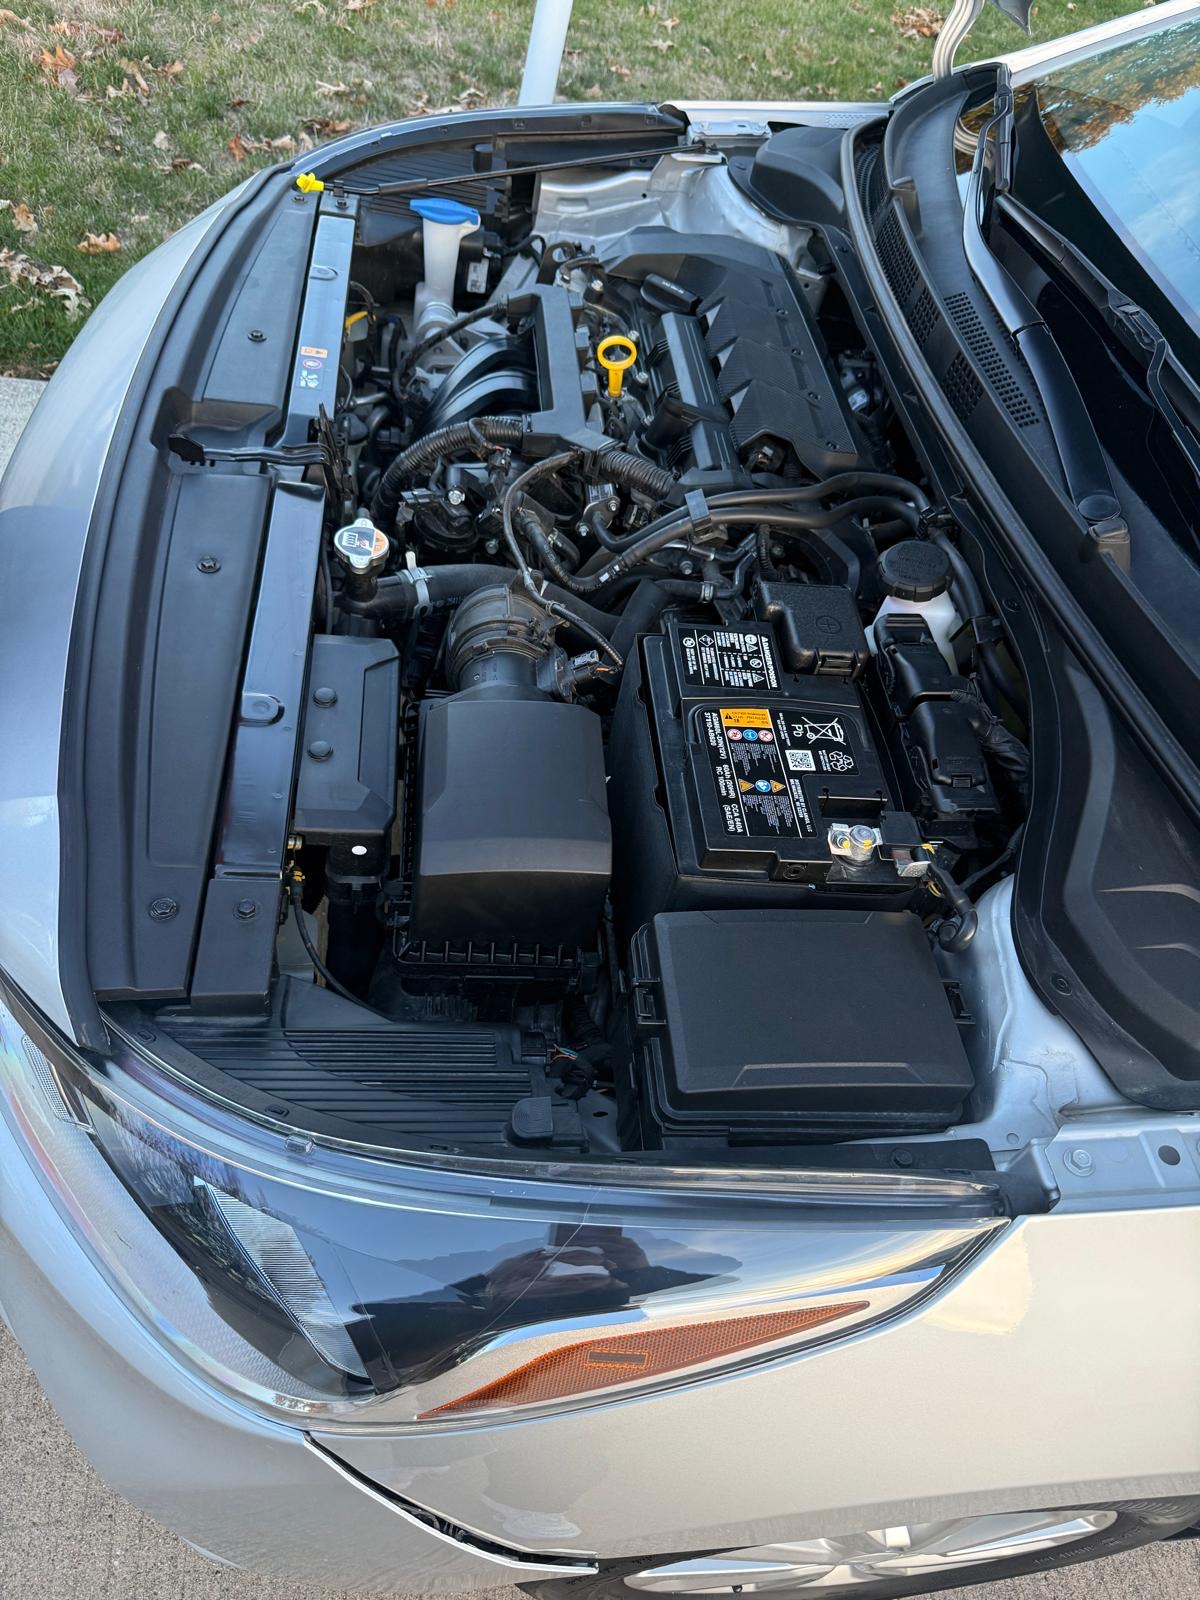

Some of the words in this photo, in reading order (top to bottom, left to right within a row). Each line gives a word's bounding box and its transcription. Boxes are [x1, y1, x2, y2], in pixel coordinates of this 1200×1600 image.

[791, 724, 804, 737] Pb
[715, 766, 724, 775] RC
[731, 803, 740, 817] CCA
[722, 804, 736, 832] (SAE/EN)
